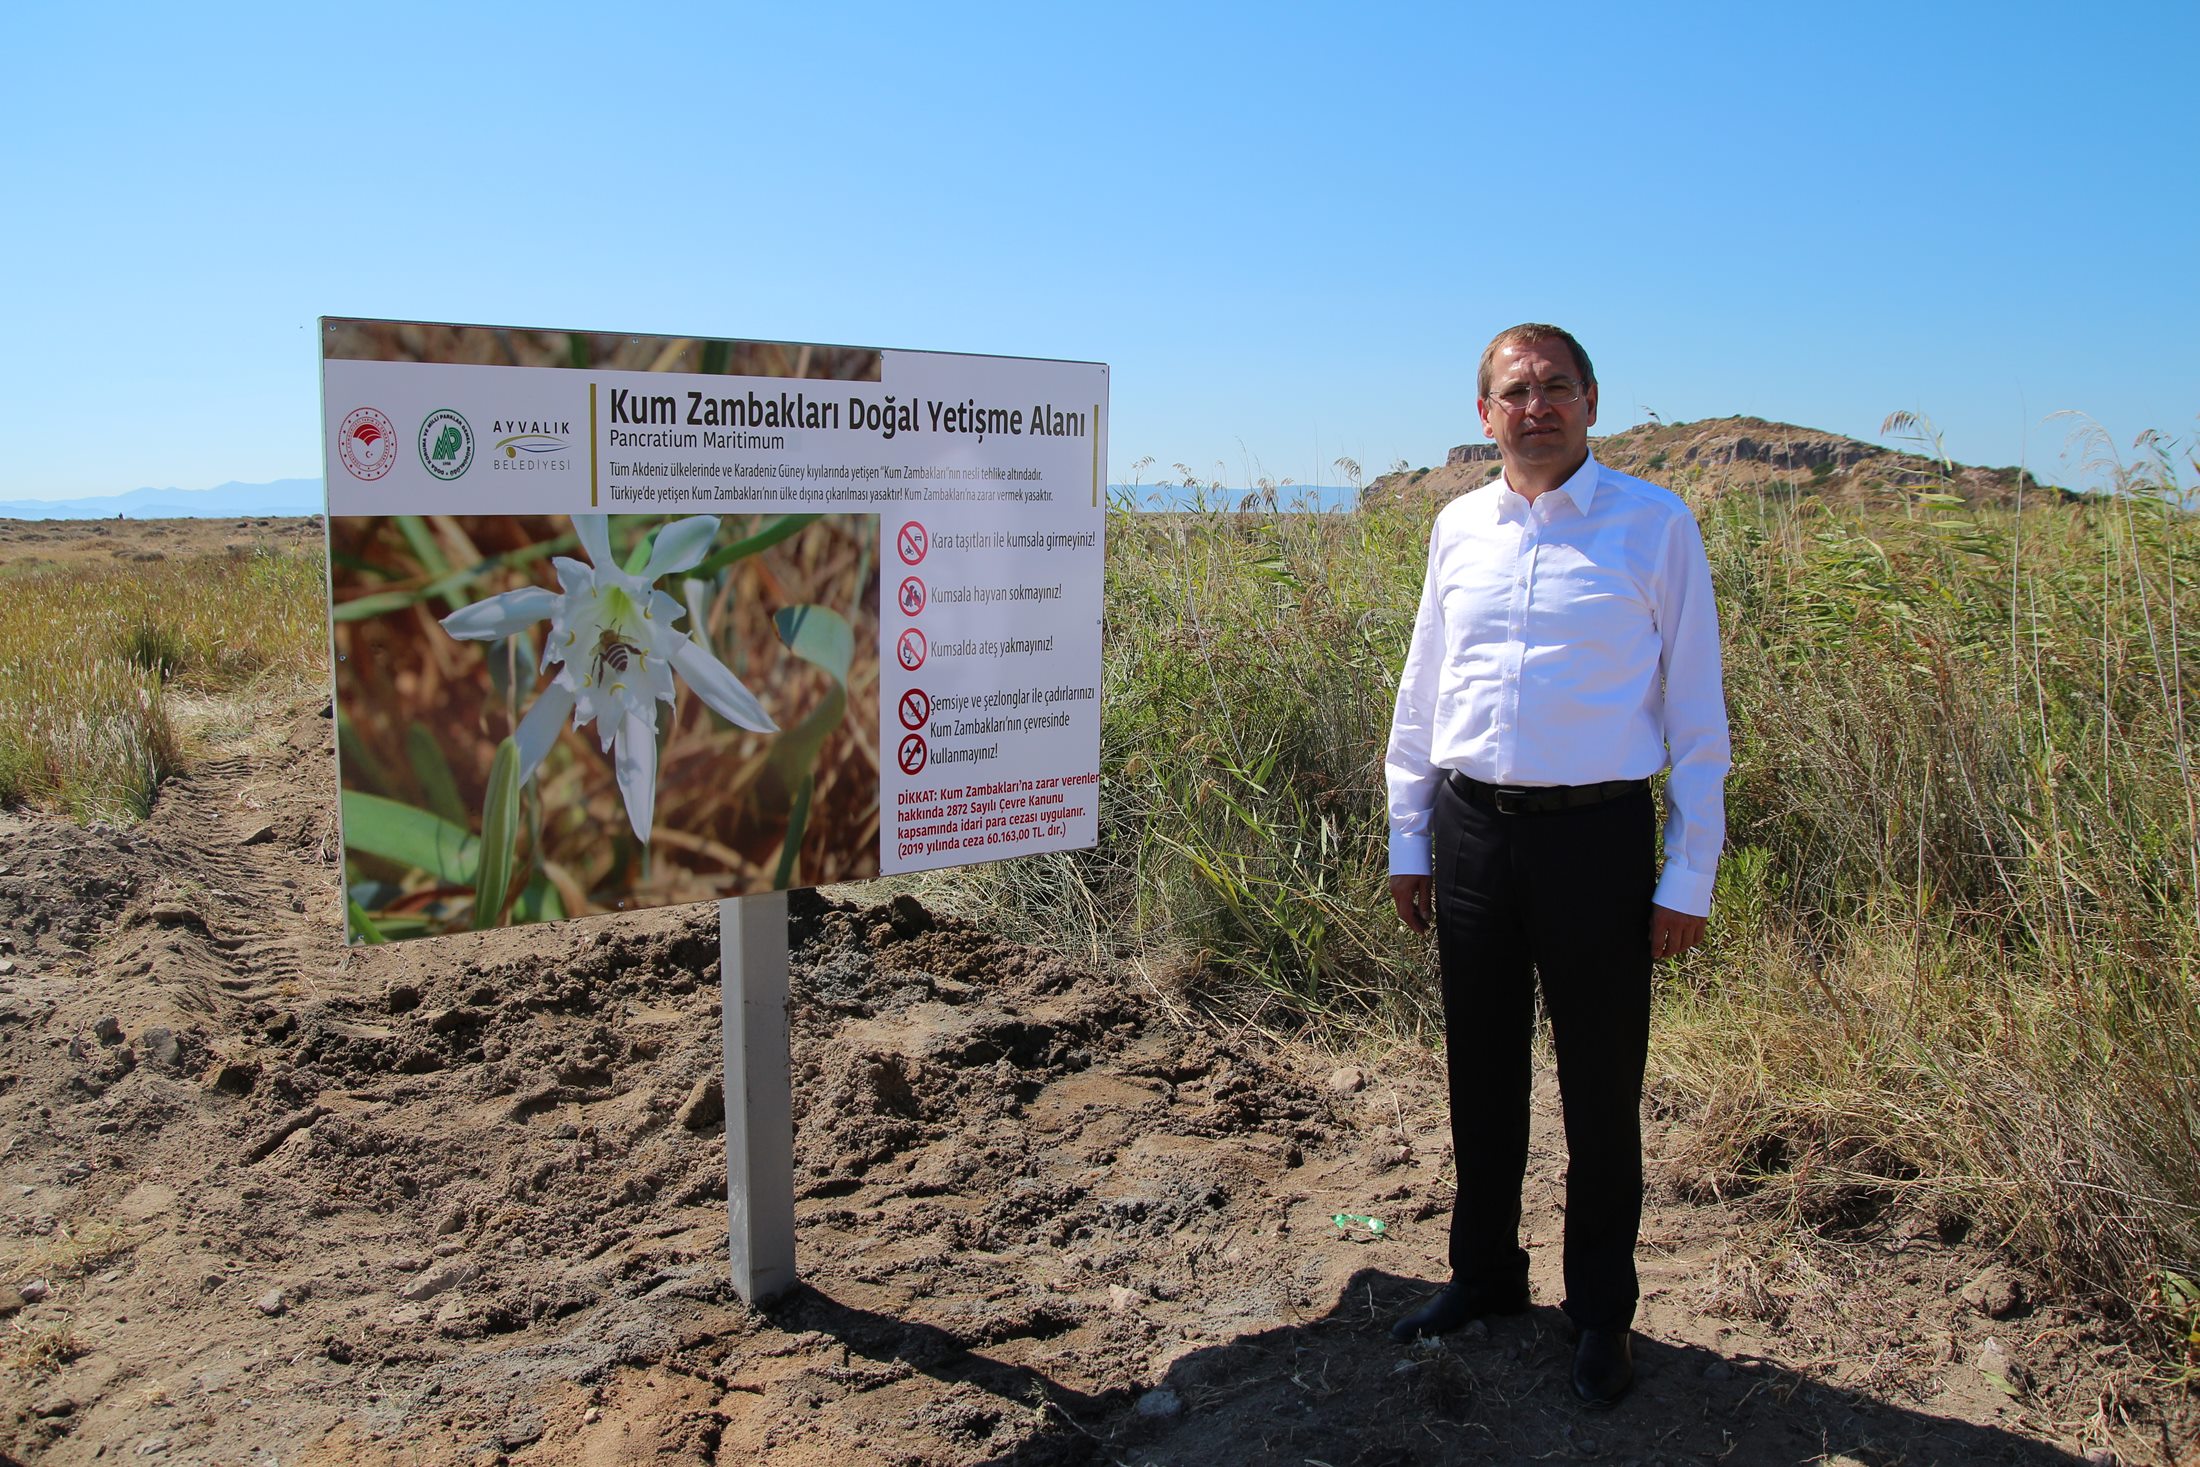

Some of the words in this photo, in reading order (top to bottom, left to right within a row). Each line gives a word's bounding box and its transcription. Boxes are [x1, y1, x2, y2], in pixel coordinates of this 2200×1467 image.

[611, 389, 676, 424] Kum
[687, 391, 839, 429] Zambakları
[849, 395, 919, 439] Doğal
[927, 398, 1022, 443] Yetişme
[1030, 404, 1085, 436] Alanı
[493, 421, 570, 434] AYVALIK
[610, 429, 697, 447] Pancratium
[703, 431, 784, 449] Maritimum
[494, 459, 570, 470] BELEDİYESİ
[610, 462, 629, 477] Tüm
[632, 462, 668, 477] Akdeniz
[670, 463, 720, 478] ülkelerinde
[722, 467, 732, 477] ve
[735, 463, 776, 478] Karadeniz
[778, 464, 804, 481] Güney
[807, 464, 849, 481] kıyılarında
[851, 466, 879, 482] yetişen
[962, 467, 980, 480] nesli
[981, 467, 1006, 480] tehlike
[1007, 467, 1043, 481] altındadır.
[657, 486, 690, 503] yetişen
[692, 486, 712, 500] Kum
[779, 487, 797, 501] ülke
[799, 487, 823, 503] dışına
[825, 487, 868, 503] çıkarılması
[870, 488, 903, 503] yasaktır!
[904, 488, 922, 500] Kum
[977, 491, 996, 501] zarar
[997, 488, 1023, 501] vermek
[1024, 489, 1053, 504] yasaktır.
[932, 533, 953, 549] Kara
[956, 531, 991, 552] taşıtları
[993, 532, 1004, 548] ile
[1007, 531, 1044, 548] kumsala
[1047, 531, 1096, 551] girmeyiniz!
[932, 586, 971, 603] Kumsala
[974, 585, 1007, 605] hayvan
[1009, 584, 1062, 603] sokmayınız!
[931, 640, 976, 657] Kumsalda
[979, 640, 998, 657] ateş
[1000, 636, 1053, 657] yakmayınız!
[930, 695, 969, 715] Şemsiye
[971, 696, 981, 708] ve
[984, 689, 1030, 711] şezlonglar
[1032, 688, 1043, 703] ile
[1045, 686, 1095, 705] çadırlarınızı
[930, 722, 952, 738] Kum
[1024, 711, 1070, 733] çevresinde
[930, 743, 998, 765] kullanmayınız!
[898, 789, 937, 805] DİKKAT:
[940, 788, 963, 801] Kum
[1035, 777, 1059, 790] zarar
[1061, 773, 1100, 787] verenler
[897, 805, 944, 822] hakkında
[946, 803, 968, 817] 2872
[970, 799, 997, 815] Sayılı
[999, 797, 1026, 814] Çevre
[1028, 792, 1064, 806] Kanunu
[897, 821, 958, 840] kapsamında
[960, 817, 983, 830] idari
[985, 816, 1007, 831] para
[1009, 813, 1038, 825] cezası
[1040, 806, 1086, 823] uygulanır.
[897, 841, 923, 860] (2019
[926, 834, 960, 857] yılında
[962, 835, 984, 848] ceza
[987, 828, 1030, 844] 60.163,00
[1032, 826, 1045, 838] TL.
[1047, 822, 1067, 838] dır.)
